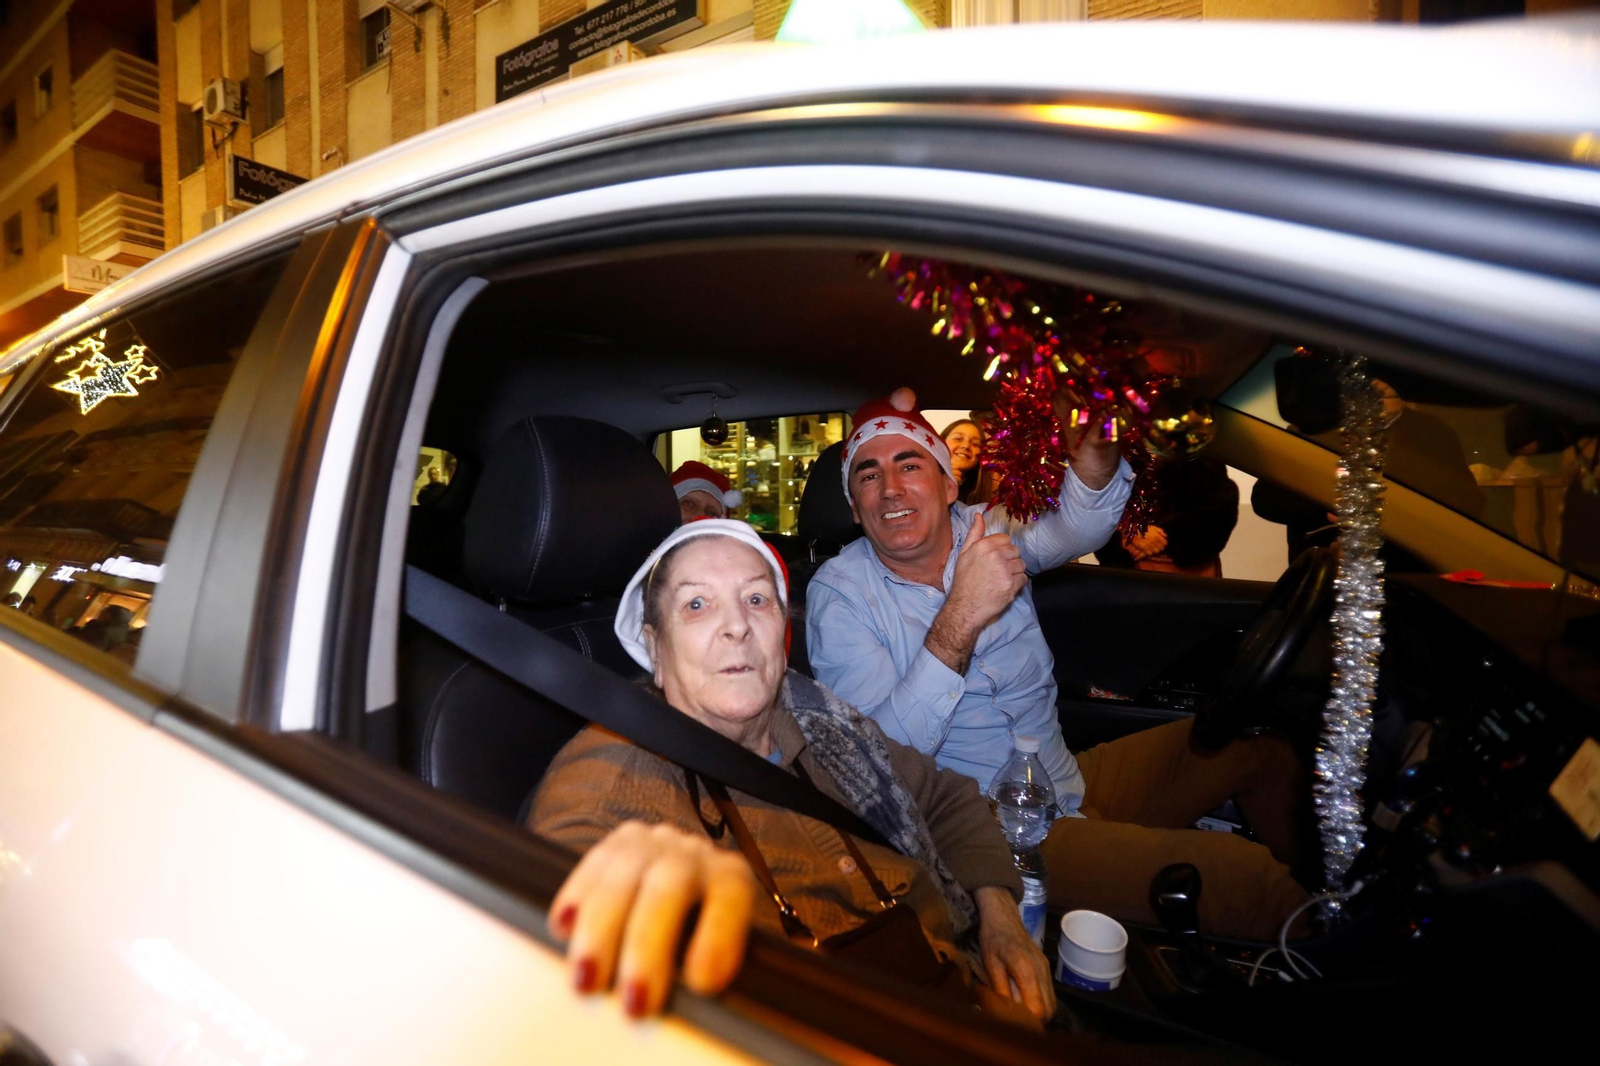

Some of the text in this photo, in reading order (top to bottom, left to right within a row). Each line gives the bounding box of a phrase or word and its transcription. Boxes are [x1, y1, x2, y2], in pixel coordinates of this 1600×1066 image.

[601, 10, 614, 23] 217
[502, 38, 559, 74] Fotógrafos
[238, 160, 298, 193] Fotógr
